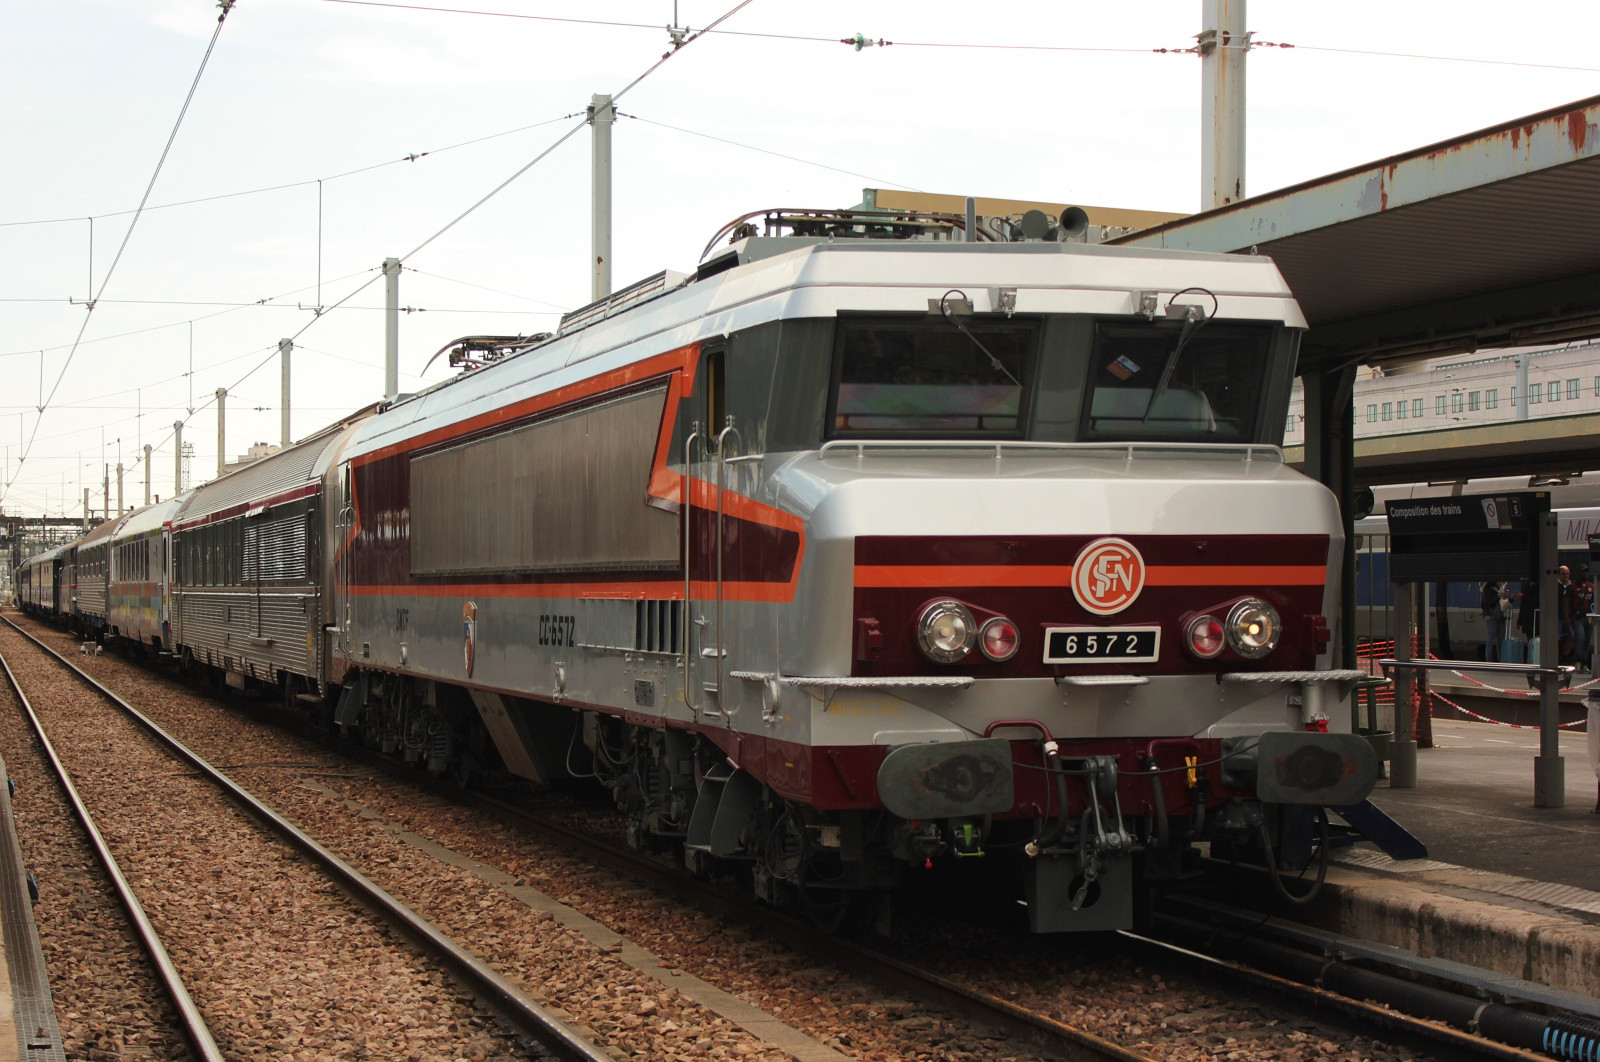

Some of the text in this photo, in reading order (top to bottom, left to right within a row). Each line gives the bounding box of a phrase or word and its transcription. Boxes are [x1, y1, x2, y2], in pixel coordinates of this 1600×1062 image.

[1389, 504, 1462, 520] Composition des trains
[1513, 504, 1519, 514] 5
[1065, 635, 1139, 655] 6572
